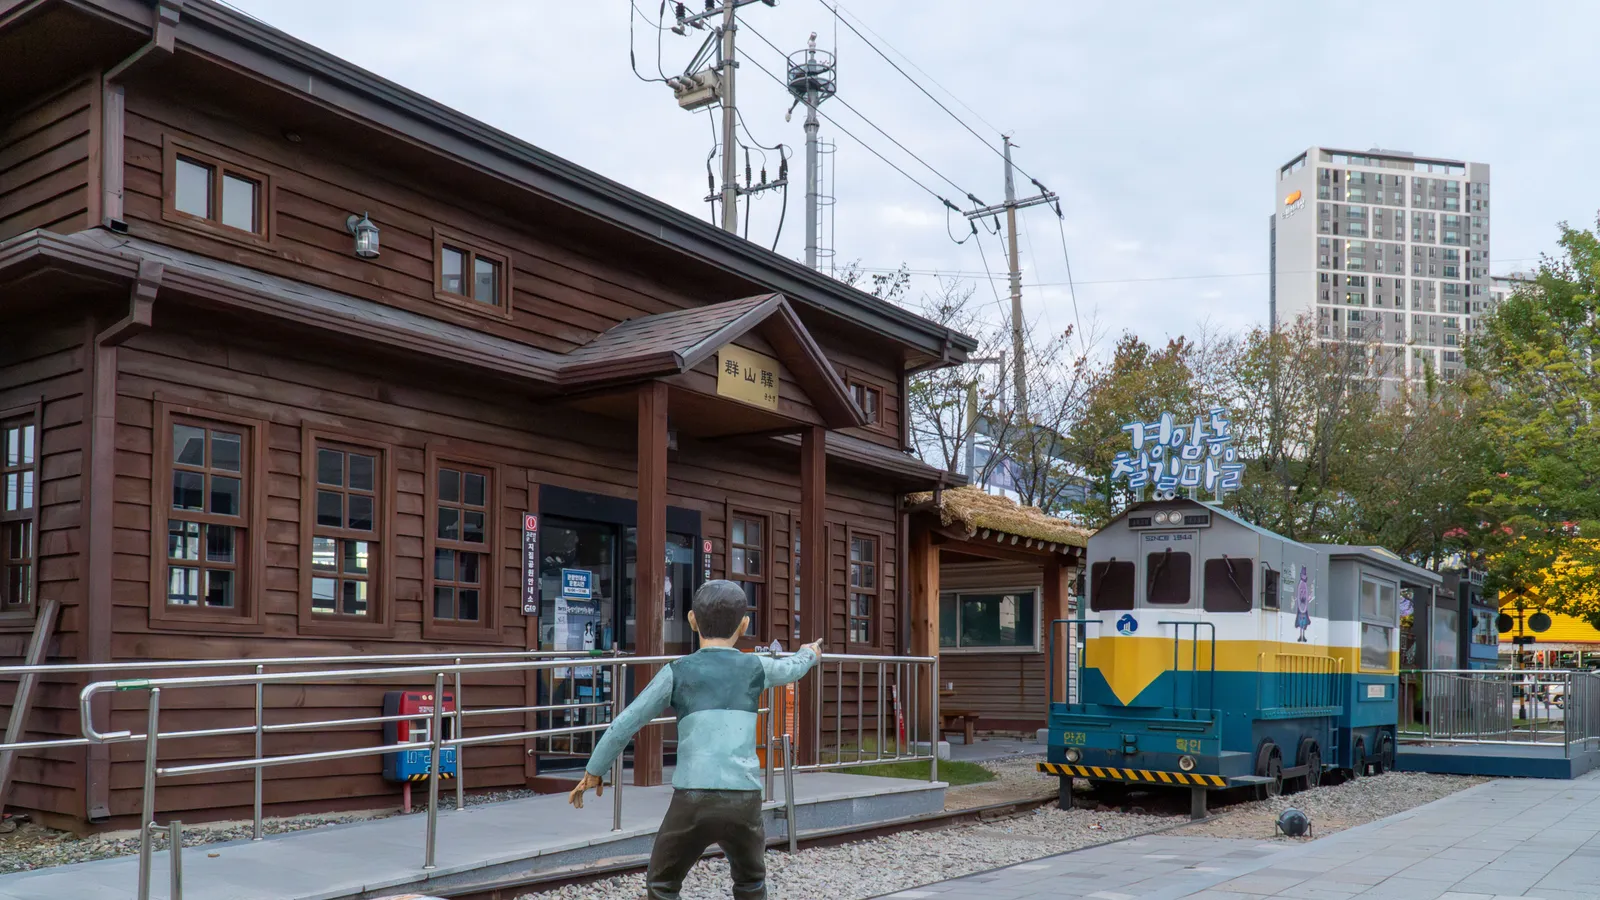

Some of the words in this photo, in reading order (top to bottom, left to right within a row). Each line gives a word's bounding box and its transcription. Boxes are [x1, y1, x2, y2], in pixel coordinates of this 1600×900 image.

[725, 359, 774, 388] 群山驛
[1121, 407, 1232, 460] 경암동
[1110, 447, 1244, 491] 철길마을
[1063, 731, 1086, 745] 안전
[1176, 738, 1201, 753] 확인
